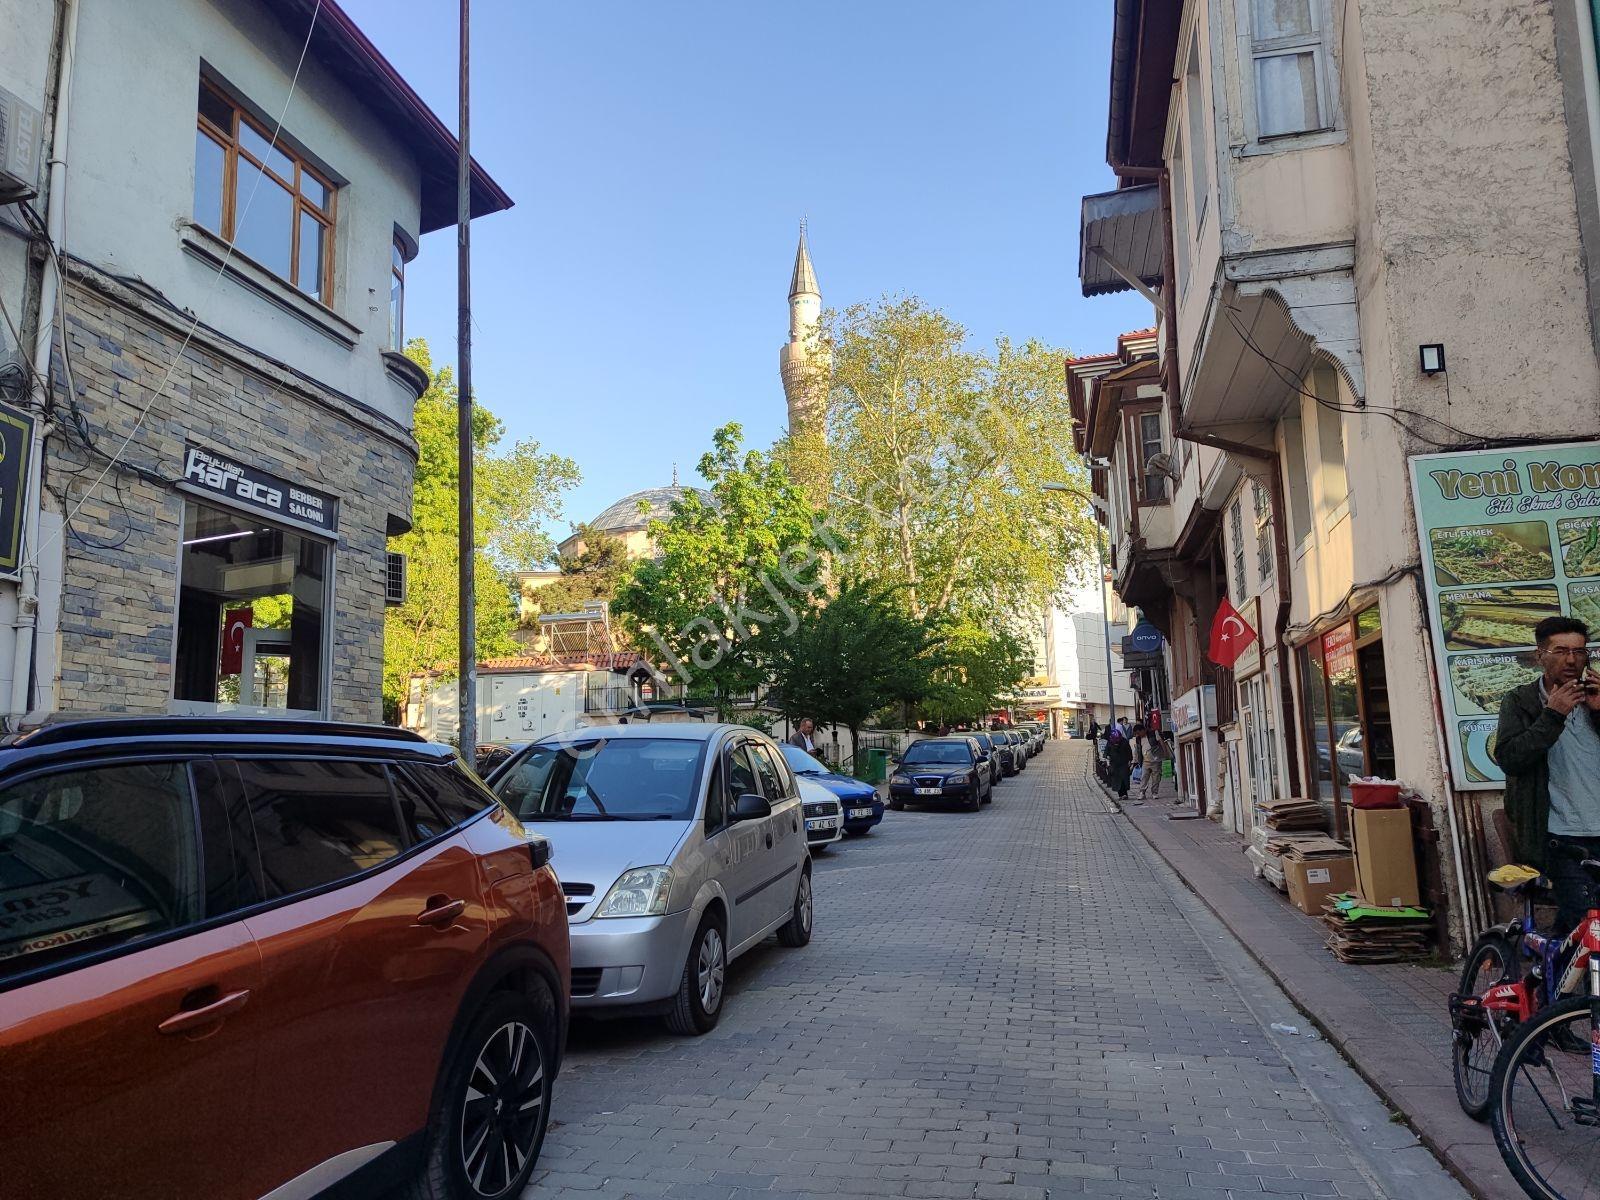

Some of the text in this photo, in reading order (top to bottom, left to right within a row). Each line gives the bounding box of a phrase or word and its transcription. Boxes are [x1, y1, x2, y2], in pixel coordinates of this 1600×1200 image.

[1429, 459, 1522, 500] Yeni
[289, 488, 323, 510] BERBER
[1517, 493, 1562, 514] Ekmek
[289, 502, 324, 523] SALONU
[1460, 528, 1493, 538] EKMEK
[1446, 591, 1493, 602] MEVLANA
